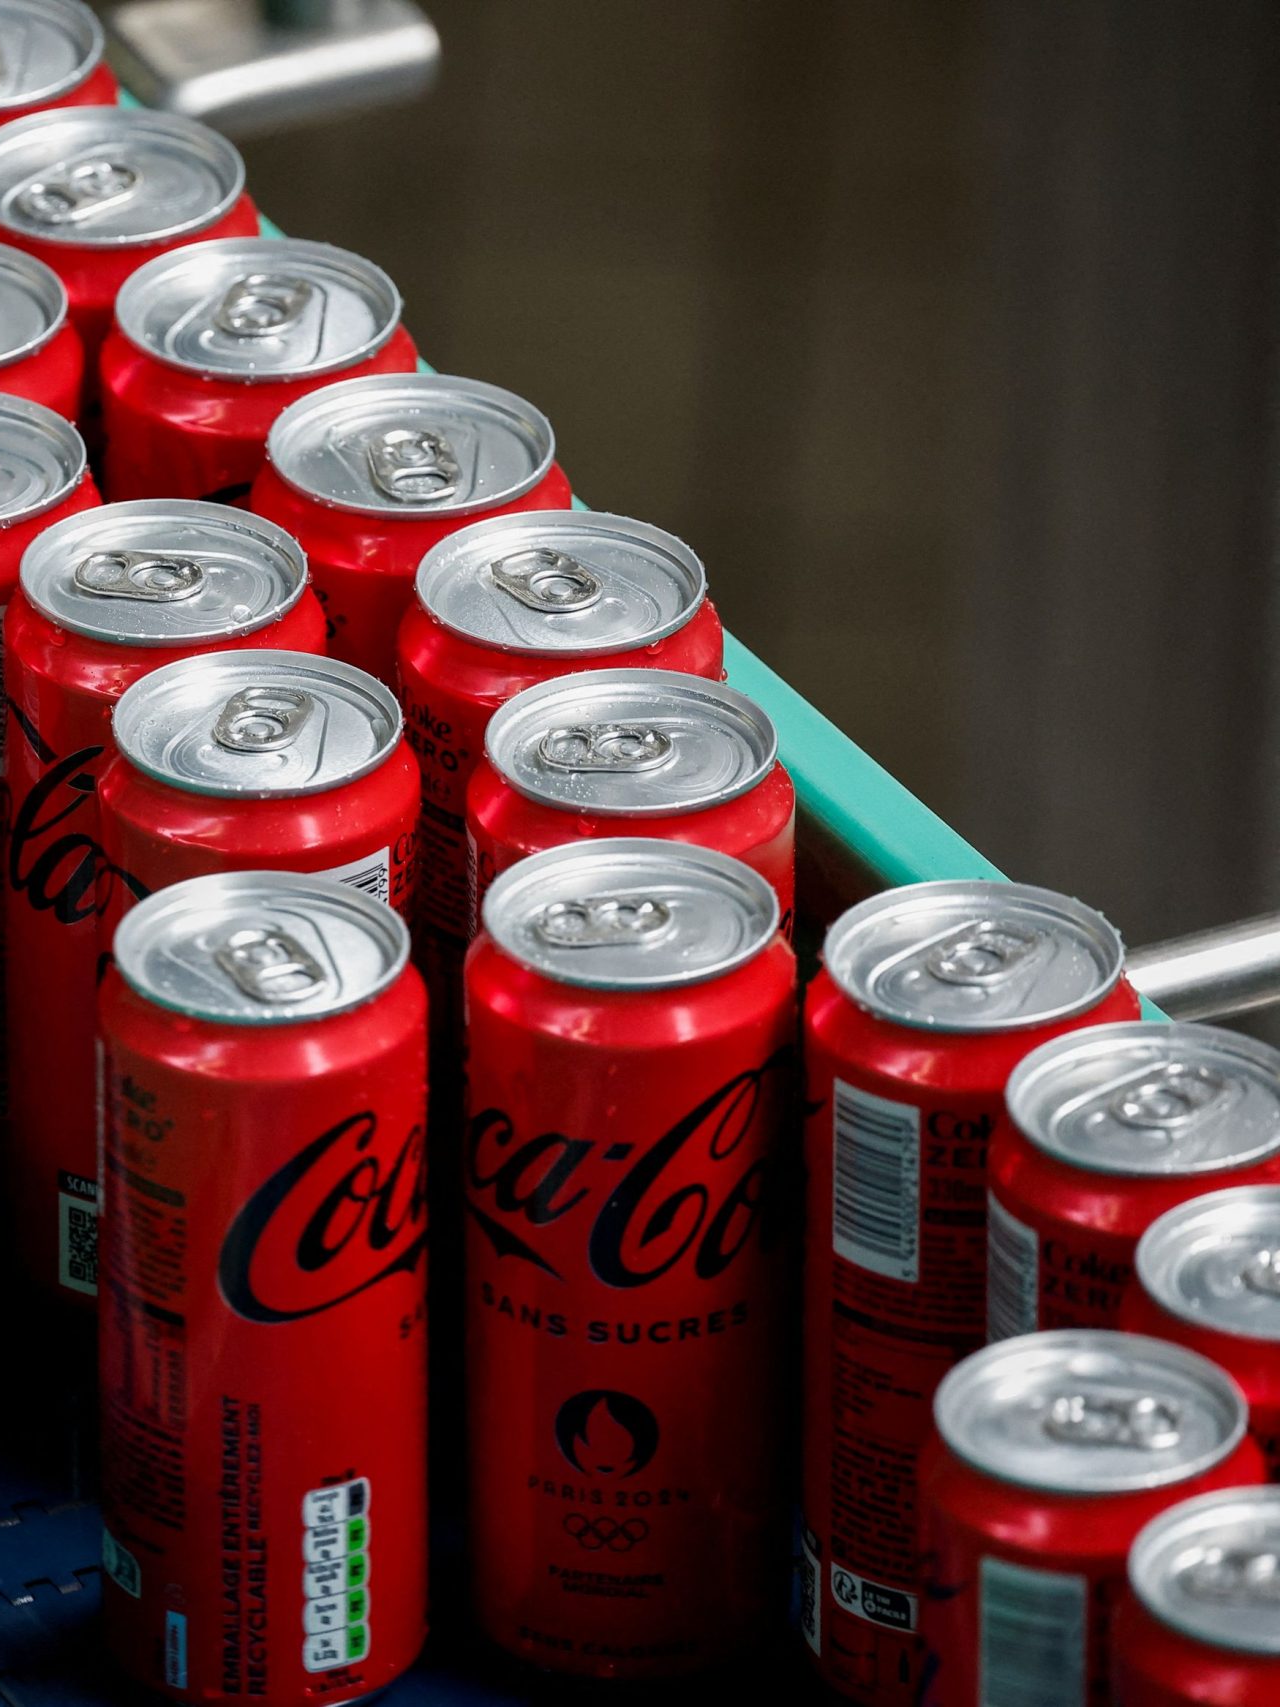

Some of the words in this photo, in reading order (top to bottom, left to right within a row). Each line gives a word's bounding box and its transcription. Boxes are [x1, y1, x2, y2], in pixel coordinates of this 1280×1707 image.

[482, 1281, 569, 1337] SANS
[585, 1302, 752, 1345] SUCRES
[221, 1556, 242, 1697] EMBALLAGE
[247, 1537, 268, 1697] RECYCLABLE
